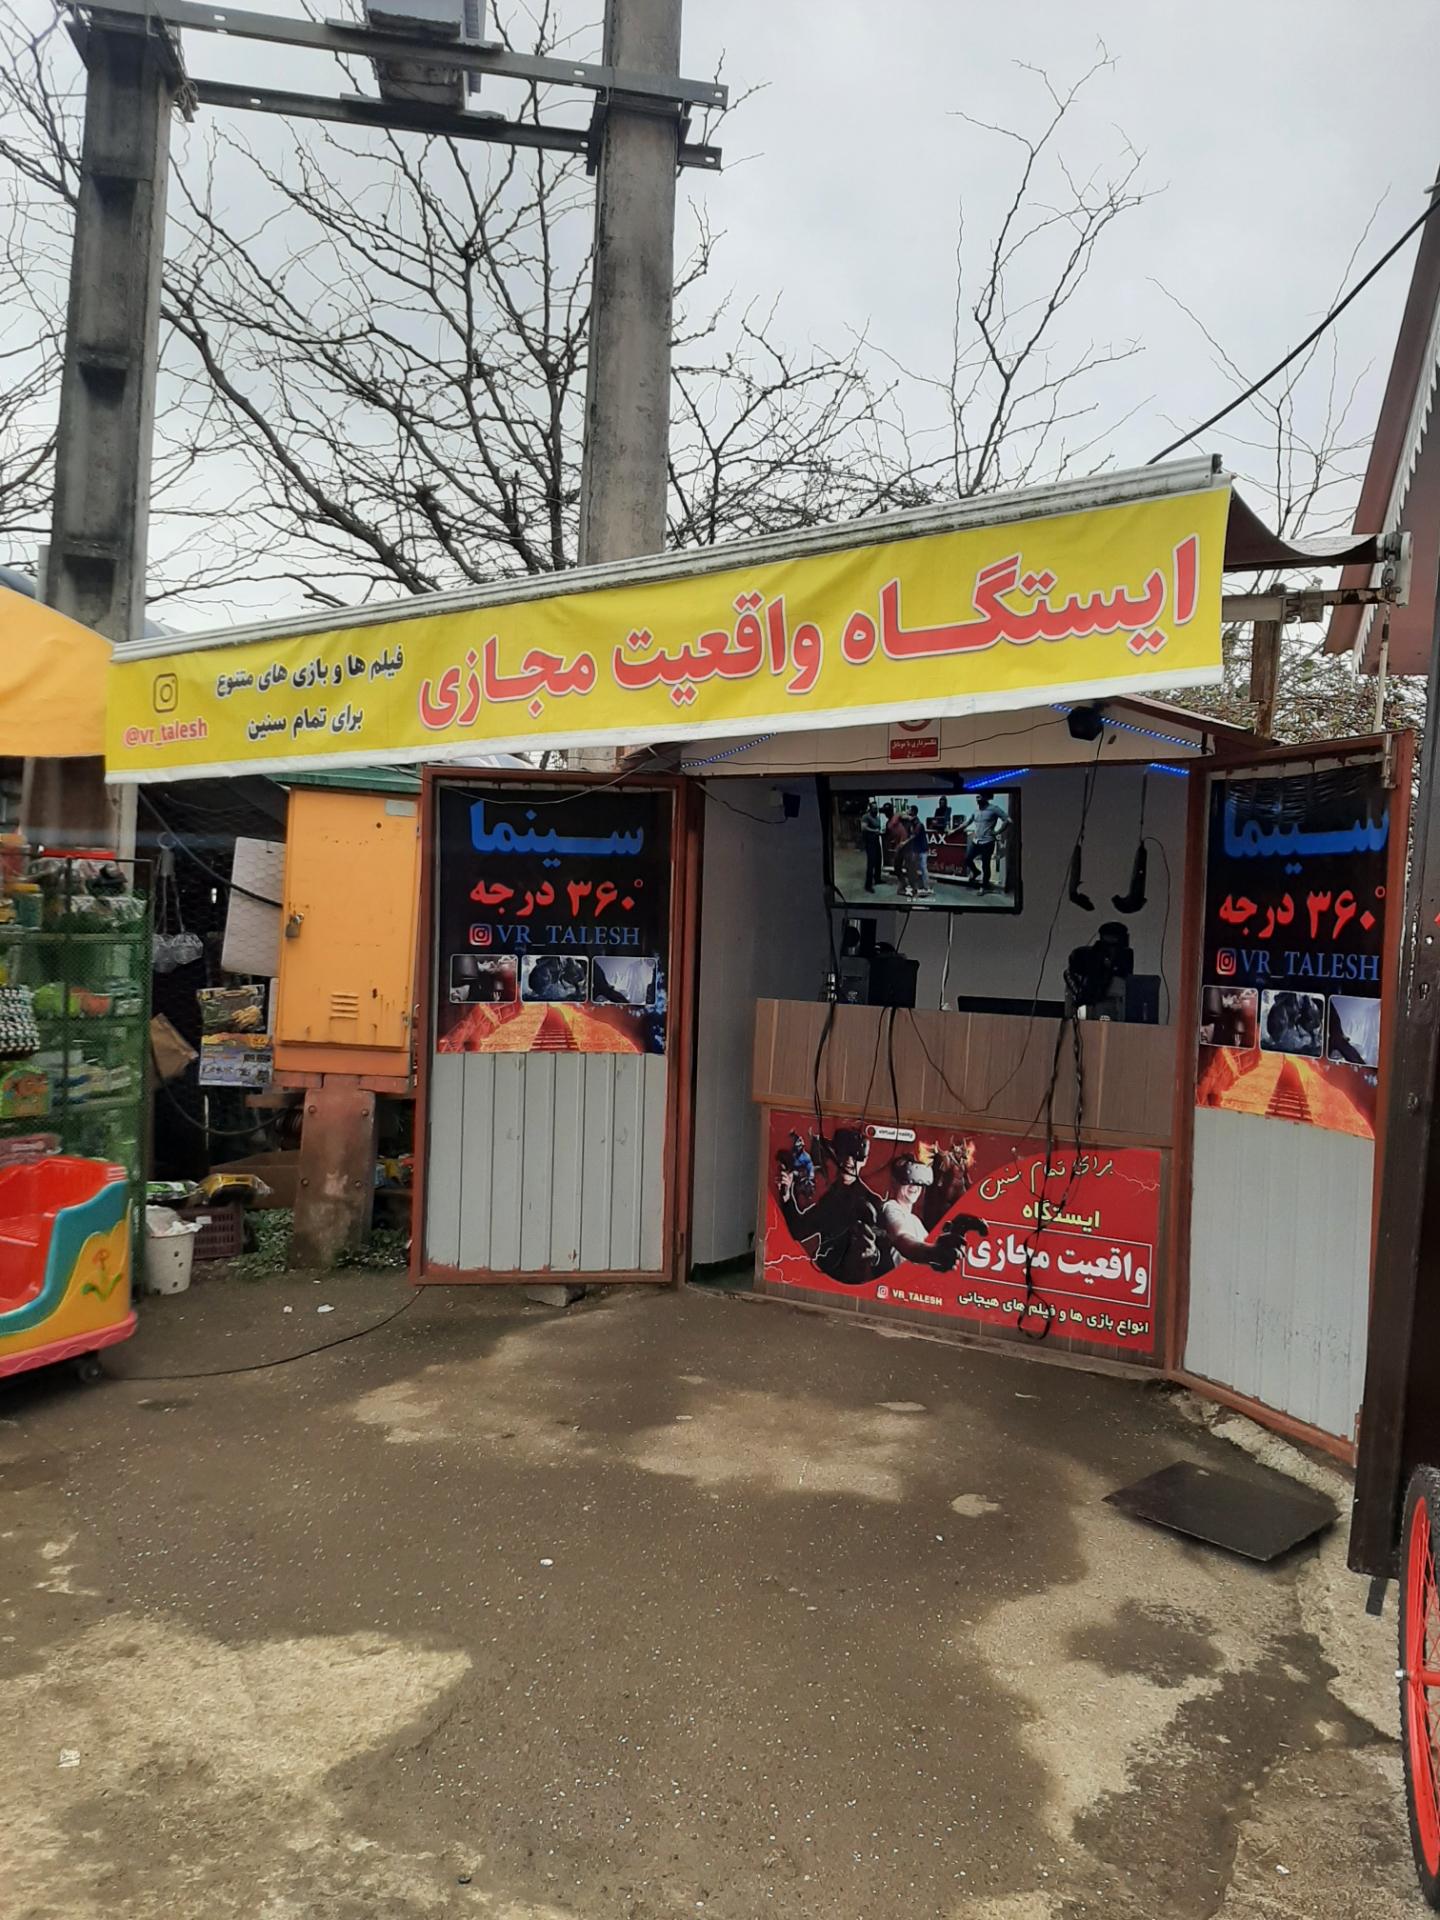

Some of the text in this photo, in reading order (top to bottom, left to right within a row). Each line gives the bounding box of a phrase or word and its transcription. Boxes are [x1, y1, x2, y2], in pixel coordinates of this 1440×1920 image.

[419, 533, 1199, 729] ایستگاه واقعیت مجازی
[216, 645, 404, 698] فیلم ها و بازی های متنوع
[124, 717, 208, 747] @vr_talesh
[248, 704, 363, 739] برای تمام سنین
[470, 800, 644, 868] سینما
[469, 880, 555, 916] درجه
[1219, 892, 1294, 938] درجه
[496, 925, 640, 947] VR_TALESH
[1240, 950, 1380, 981] VR_TALESH
[1072, 1155, 1113, 1176] برای
[979, 1167, 1022, 1200] سنین
[1022, 1200, 1100, 1232] ایستگاه
[967, 1233, 1148, 1294] واقعیت مجازی
[892, 1288, 943, 1306] VR_TALESH
[958, 1291, 1149, 1336] انواع بازی ها و فیلم های هیجانی
